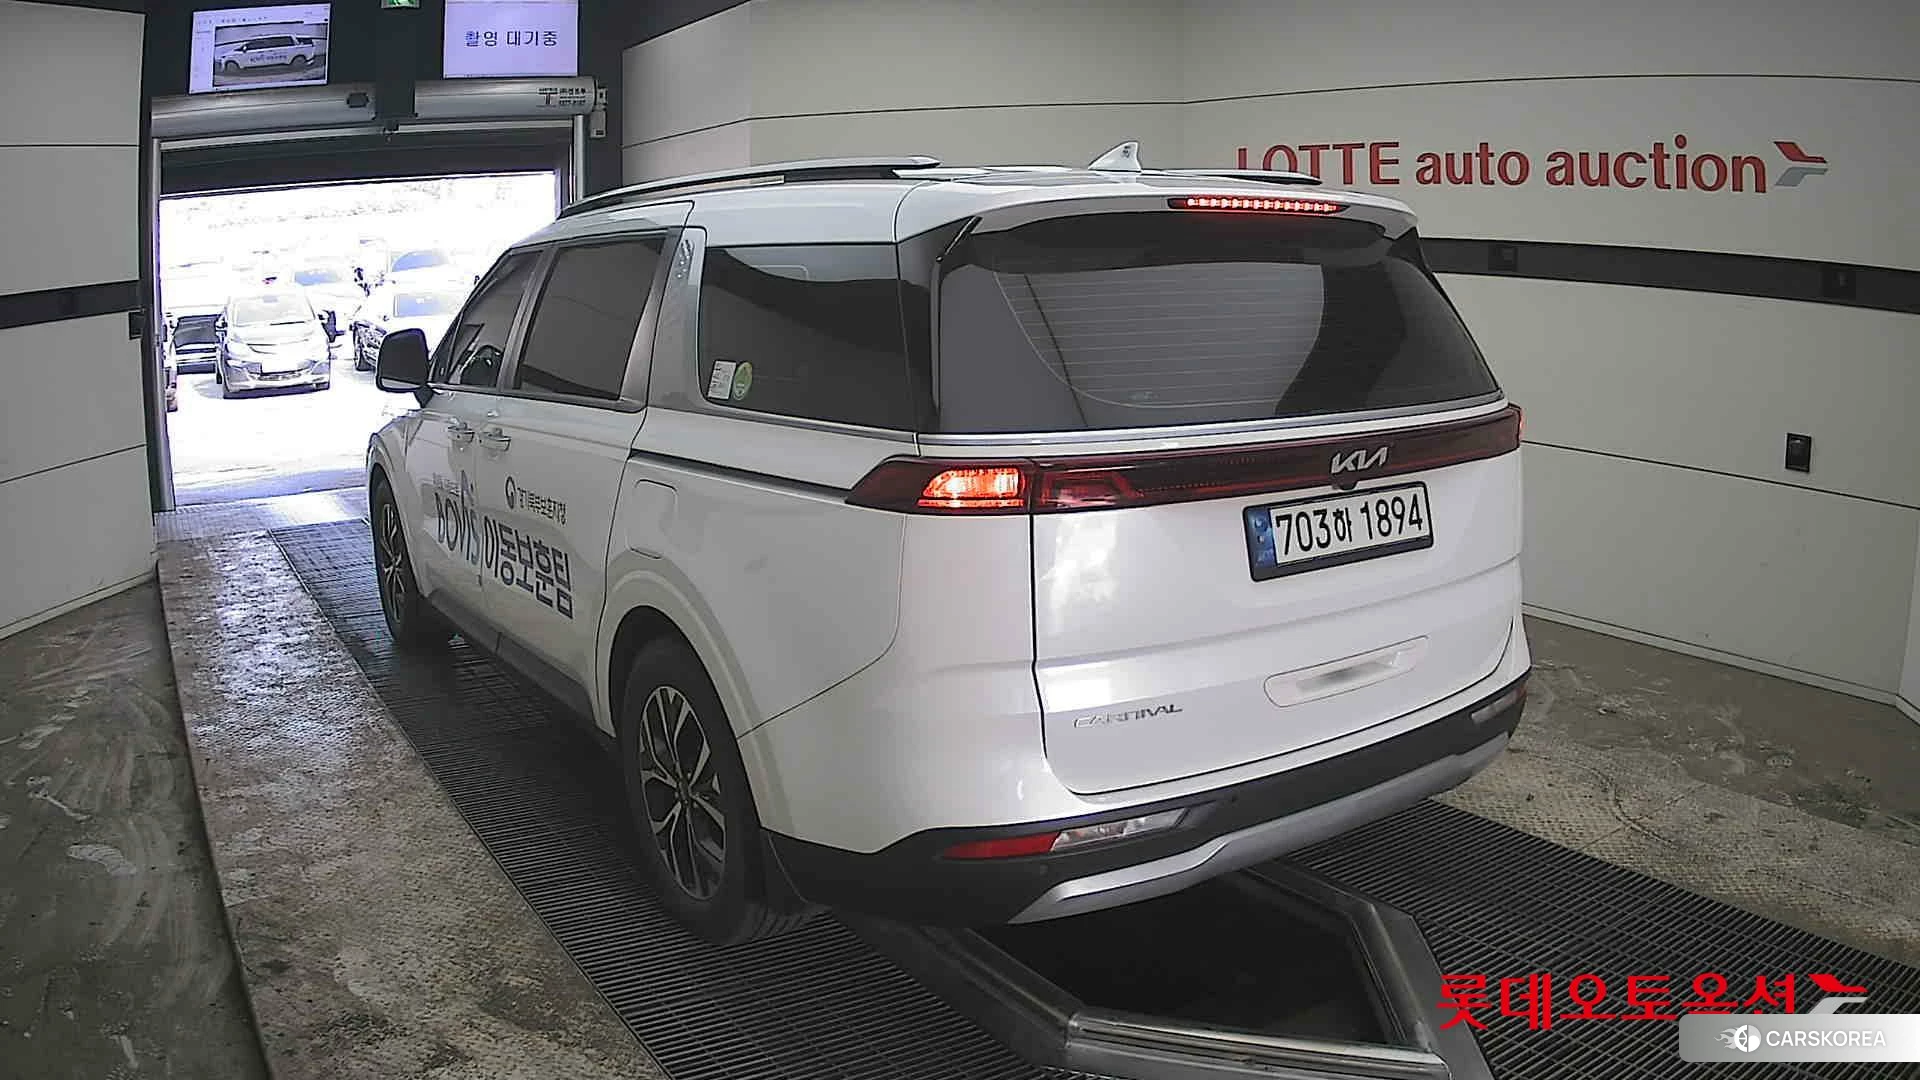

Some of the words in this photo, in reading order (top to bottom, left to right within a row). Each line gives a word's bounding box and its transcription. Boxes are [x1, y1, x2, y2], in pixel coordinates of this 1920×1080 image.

[506, 30, 558, 47] 대기중
[1415, 142, 1530, 187] auto
[1545, 133, 1767, 195] auction
[1331, 446, 1389, 475] KIA
[1360, 493, 1423, 540] 1894
[483, 515, 574, 620] 이동보훈팀
